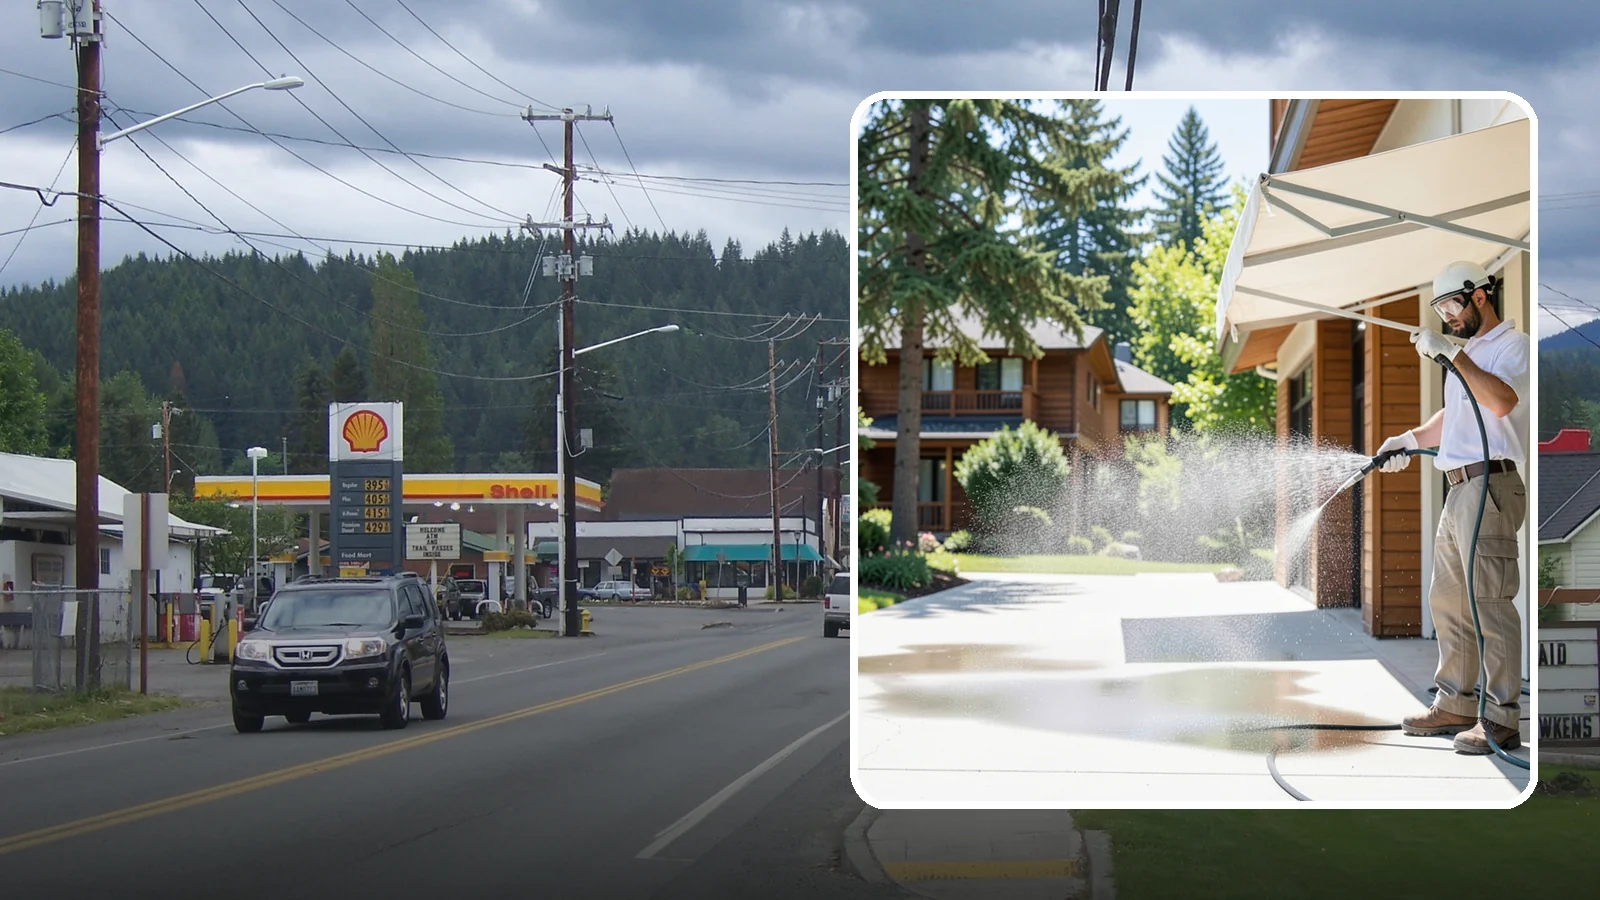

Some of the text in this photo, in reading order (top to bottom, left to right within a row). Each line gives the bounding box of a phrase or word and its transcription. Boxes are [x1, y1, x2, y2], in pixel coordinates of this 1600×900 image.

[366, 480, 383, 490] 395
[490, 484, 547, 499] Shell
[366, 494, 383, 504] 405
[366, 508, 383, 518] 415
[366, 522, 383, 533] 429
